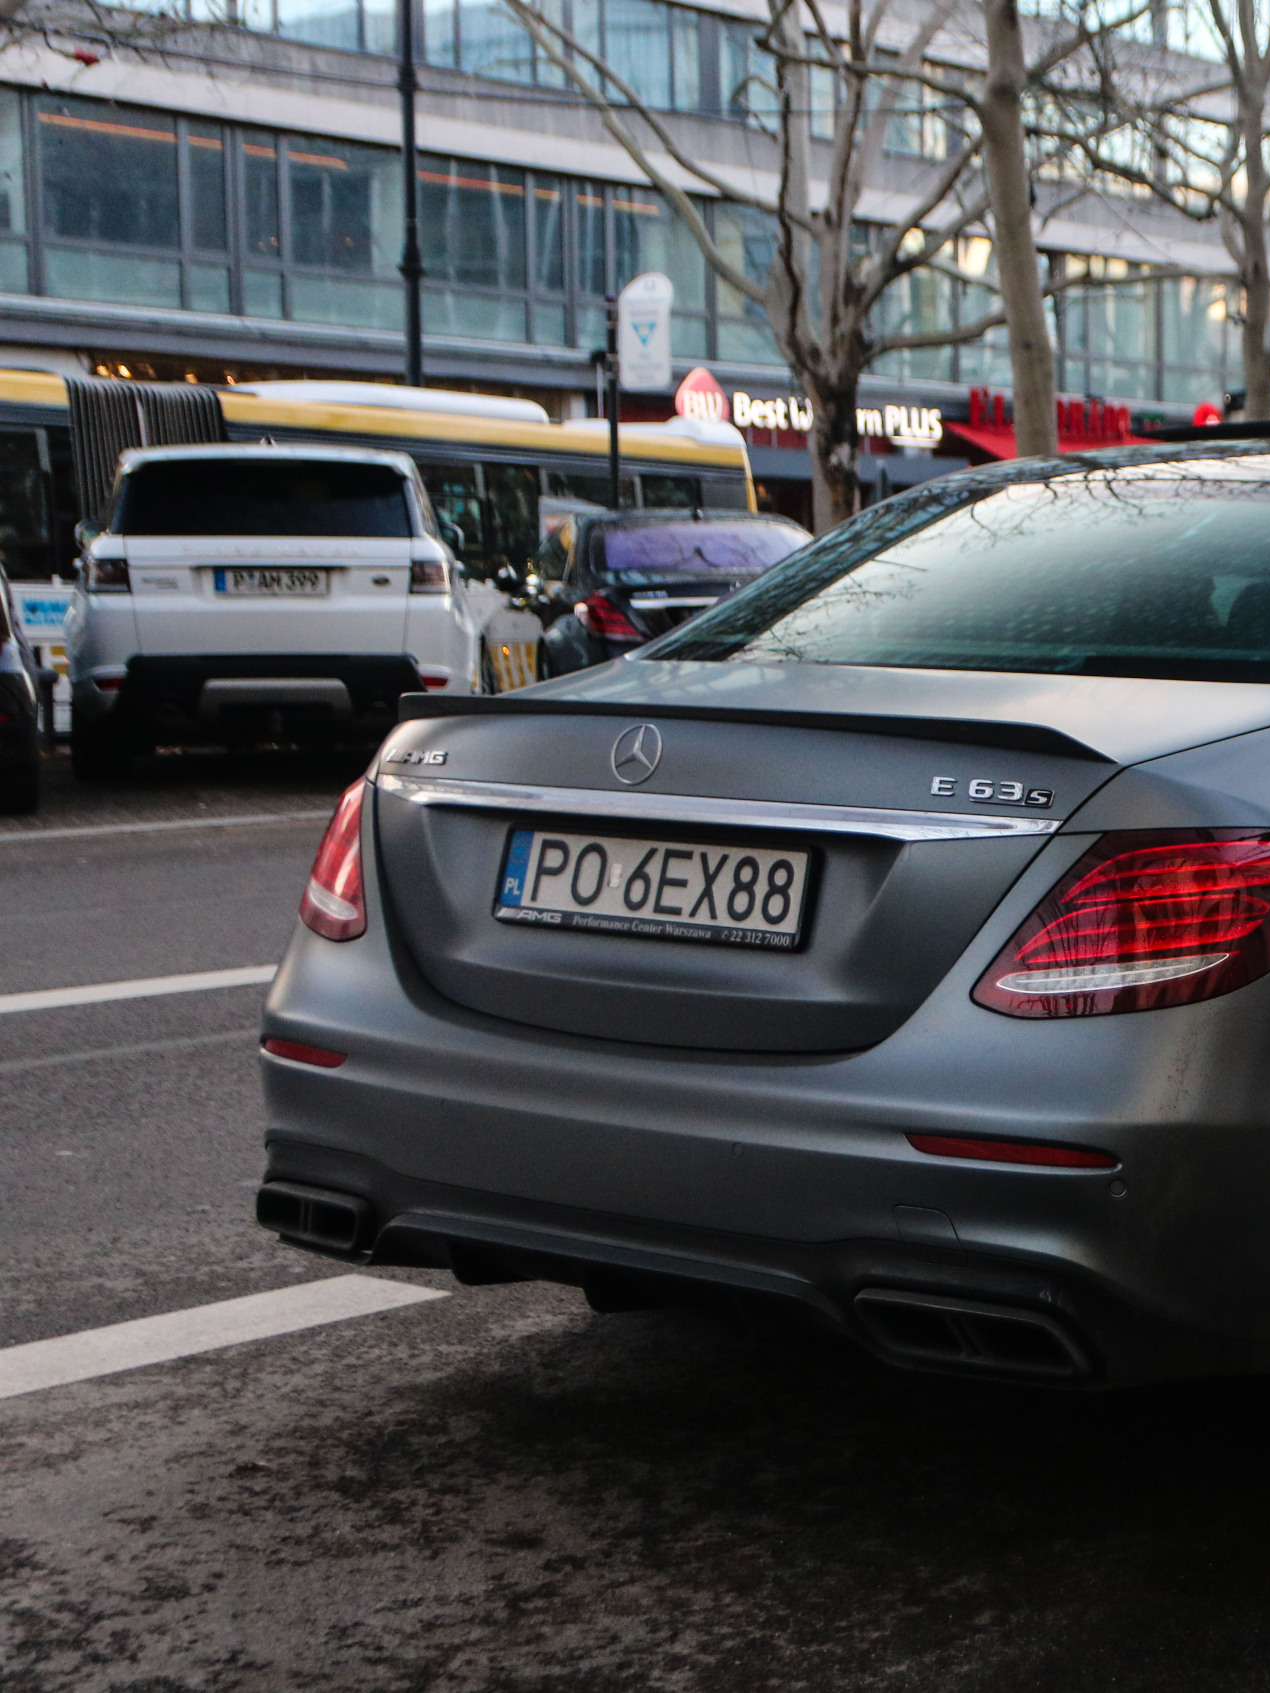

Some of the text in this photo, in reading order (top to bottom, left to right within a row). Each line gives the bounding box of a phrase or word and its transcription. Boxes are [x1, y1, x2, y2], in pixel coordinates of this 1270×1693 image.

[733, 392, 788, 430] Best
[885, 404, 943, 441] PLUS
[504, 878, 520, 894] PL
[517, 909, 790, 946] AMG Performance Center Warszawa 22 312 7000
